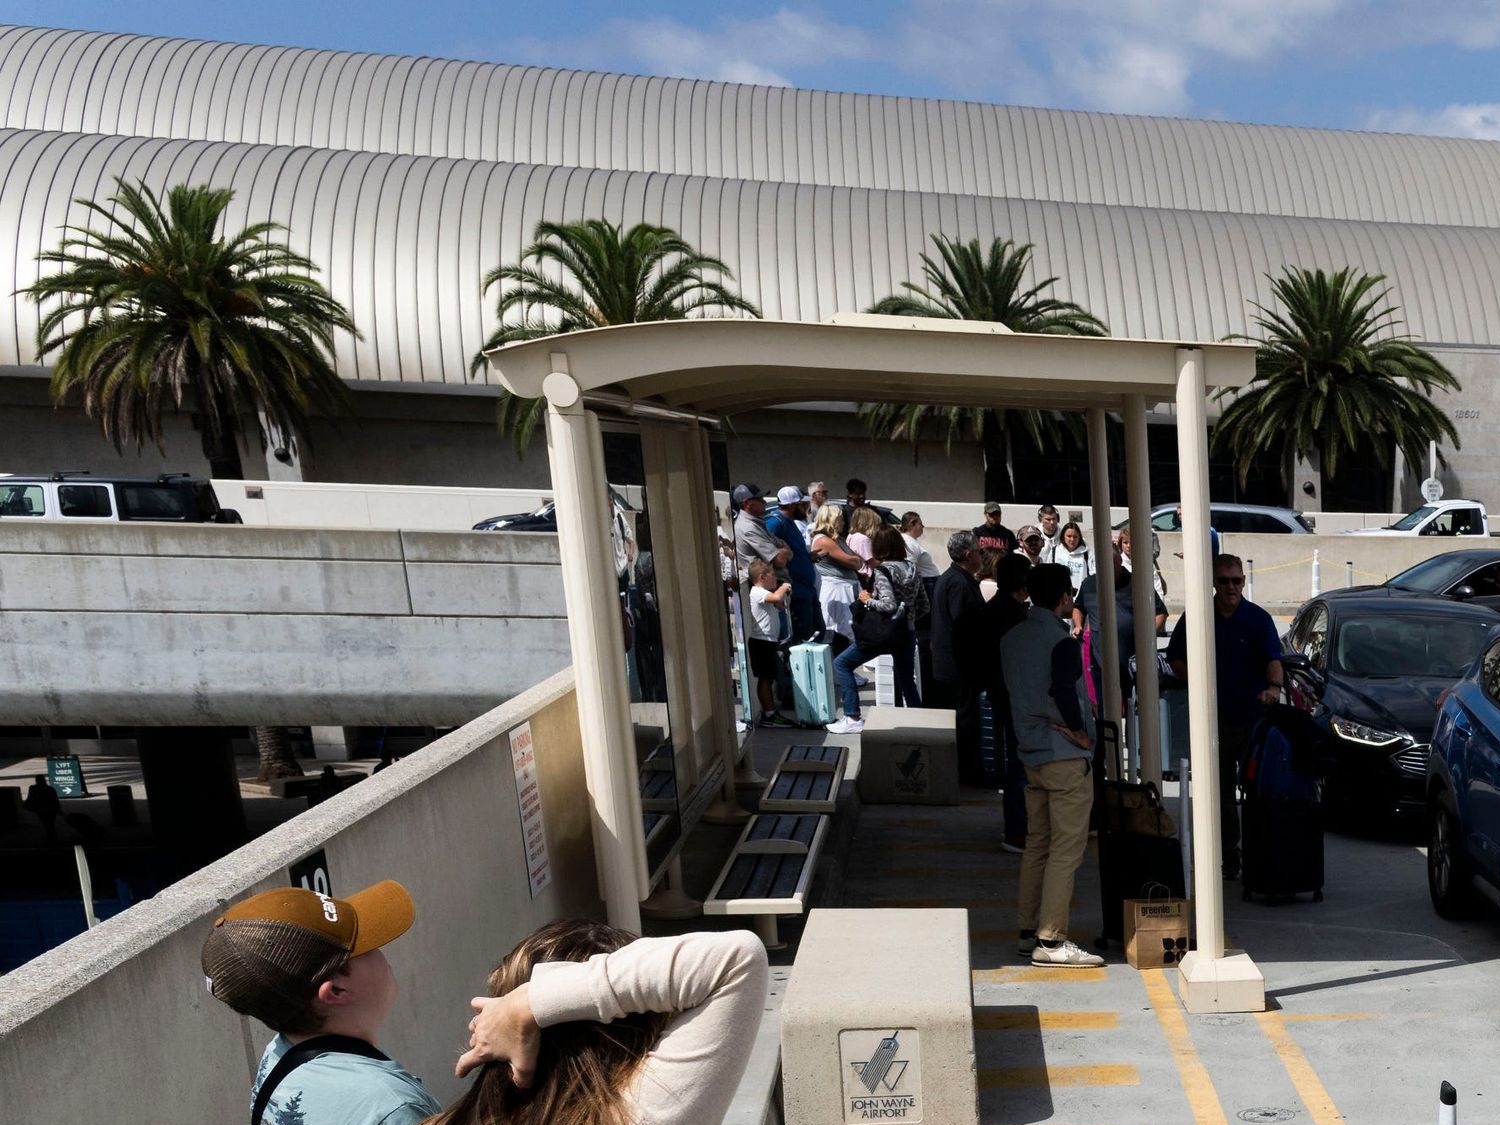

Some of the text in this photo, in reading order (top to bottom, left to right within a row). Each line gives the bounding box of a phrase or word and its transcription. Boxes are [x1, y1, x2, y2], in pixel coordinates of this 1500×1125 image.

[851, 1098, 916, 1112] JOHN WAYNE
[861, 1108, 907, 1119] AIRPORT
